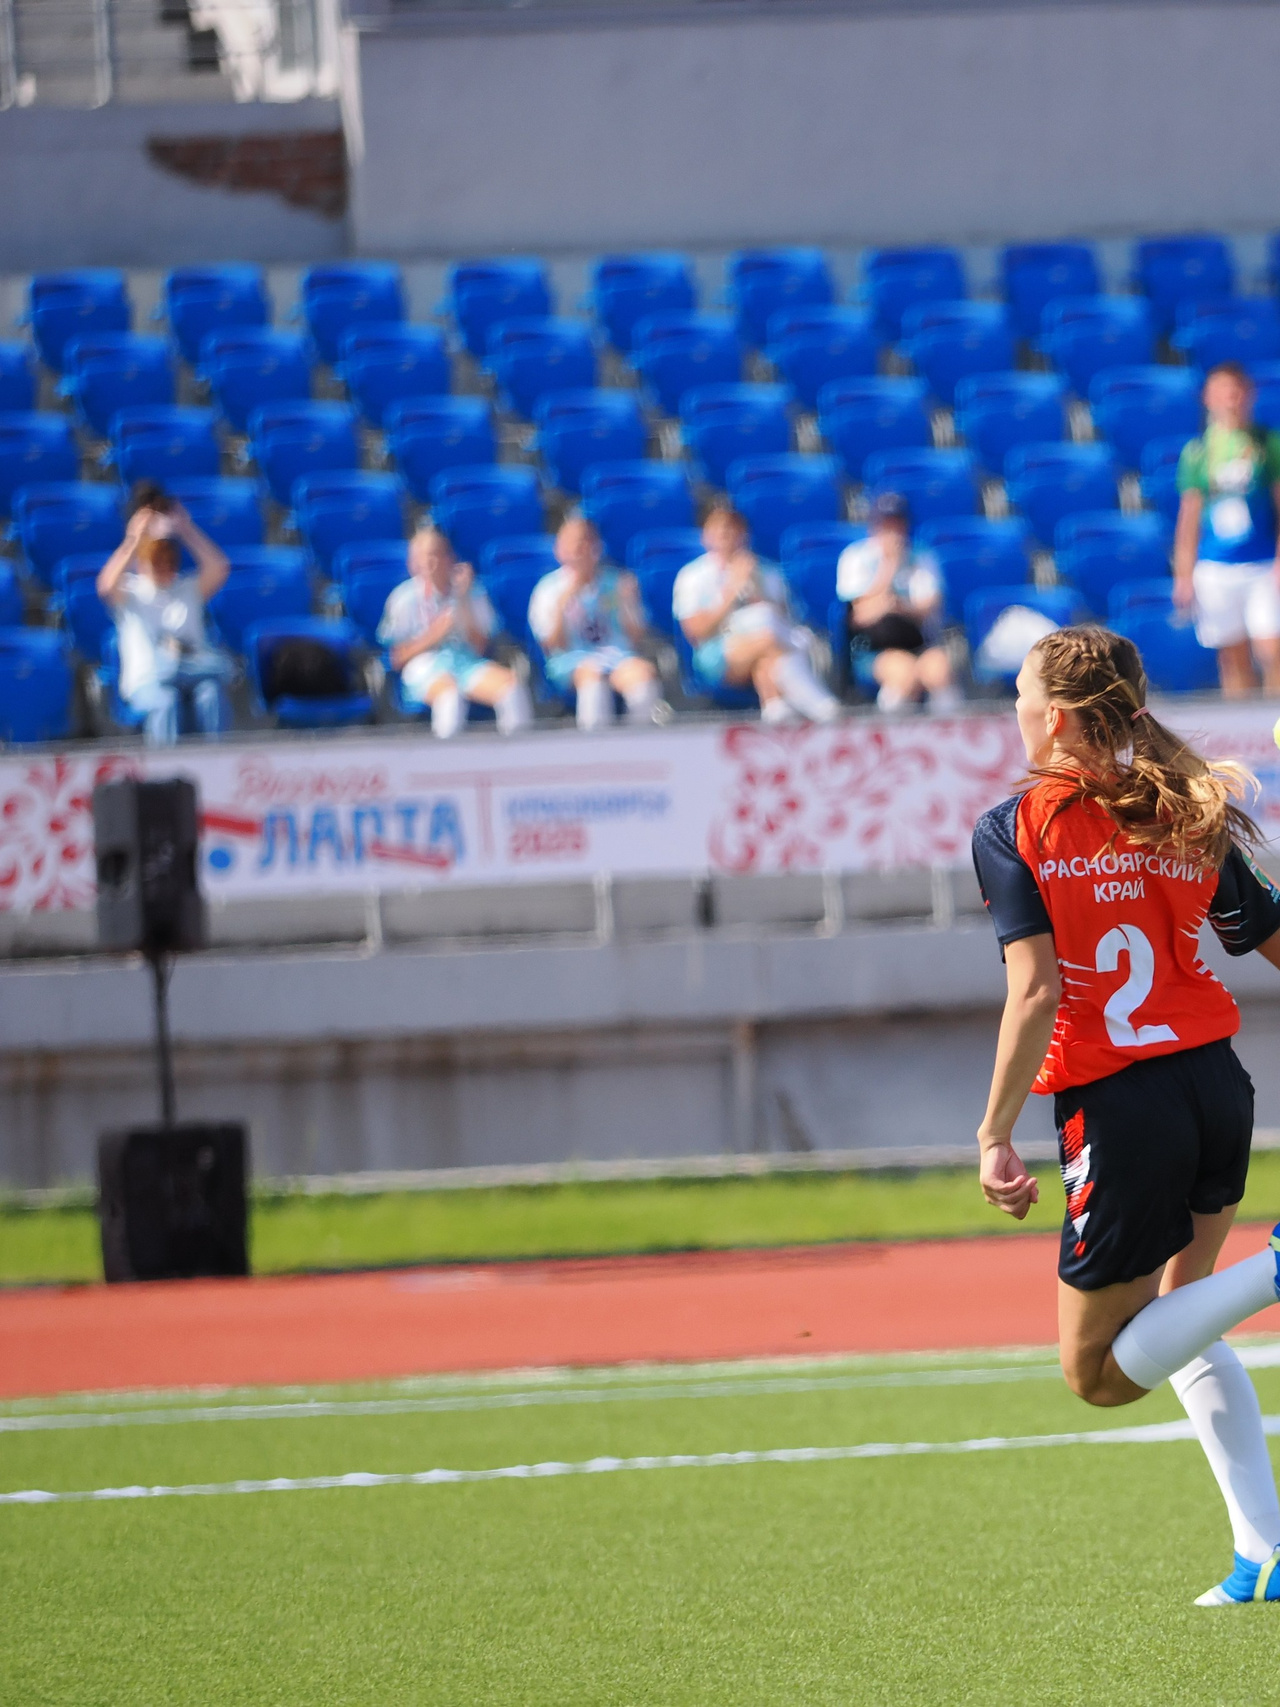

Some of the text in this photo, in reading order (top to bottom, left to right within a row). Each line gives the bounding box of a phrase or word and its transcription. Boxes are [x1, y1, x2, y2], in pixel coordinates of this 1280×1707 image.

[257, 799, 464, 868] ЛАПТА
[1093, 877, 1145, 903] КРАЙ
[1095, 923, 1180, 1047] 2
